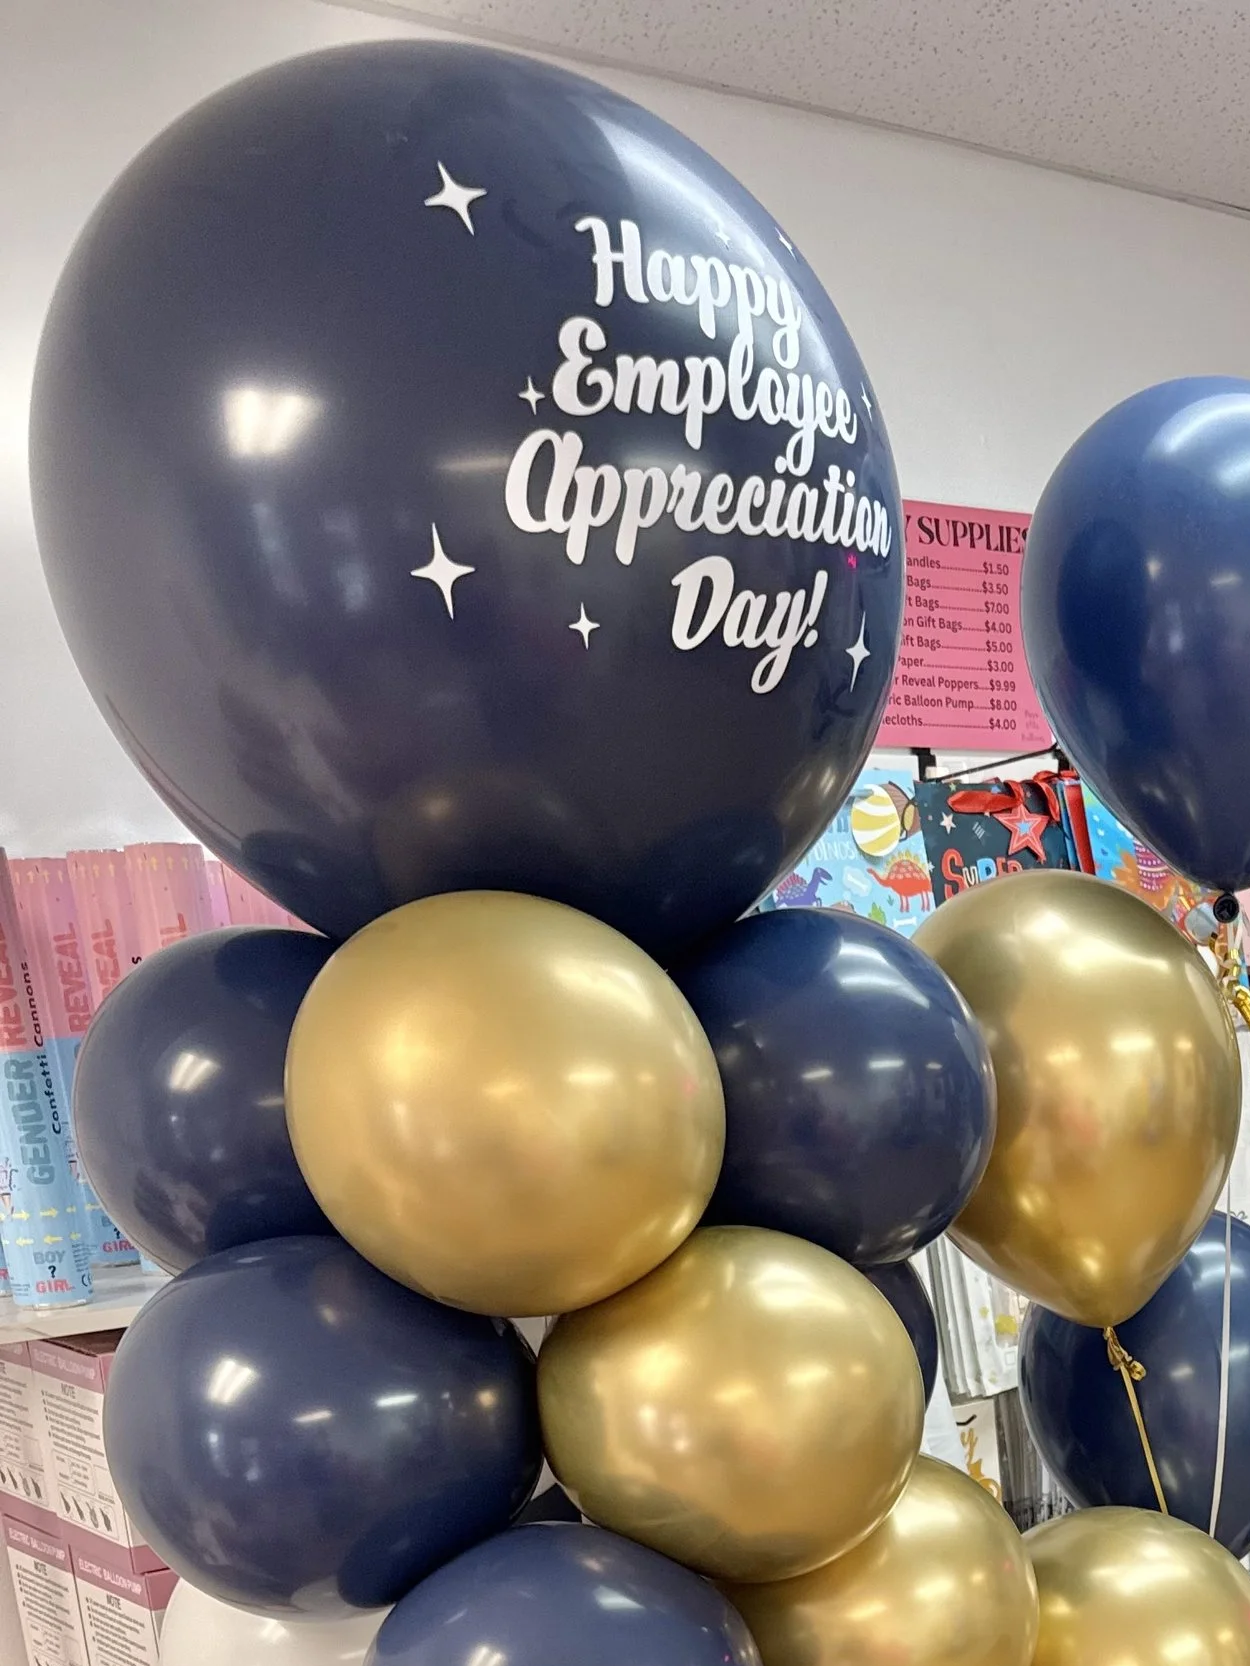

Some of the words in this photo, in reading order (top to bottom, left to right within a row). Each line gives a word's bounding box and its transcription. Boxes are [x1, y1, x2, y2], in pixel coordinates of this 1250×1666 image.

[574, 216, 801, 368] Happy
[552, 316, 858, 476] Employee
[505, 428, 892, 565] Appreciation
[906, 556, 941, 569] andles
[907, 575, 931, 590] Bags
[982, 581, 1009, 595] $3.50
[915, 596, 940, 611] Bags
[671, 554, 828, 694] Day!
[916, 616, 935, 629] Gift
[938, 617, 963, 633] Bags
[985, 620, 1012, 634] $4.00
[901, 634, 914, 647] ift
[917, 635, 942, 651] Bags
[986, 639, 1013, 654] $5.00
[899, 656, 925, 669] aper
[987, 660, 1014, 673] $3.00
[902, 674, 935, 688] Reveal
[938, 676, 979, 692] Poppers
[989, 679, 1016, 692] $9.99
[904, 694, 942, 708] Balloon
[945, 696, 974, 712] Pump
[882, 714, 923, 727] ecloths
[989, 718, 1017, 731] $4.00
[53, 922, 93, 1034] REVEAL
[20, 961, 44, 1048] Cannons
[36, 1054, 62, 1135] Confetti
[4, 1057, 55, 1186] GENDER
[33, 1250, 67, 1265] BOY
[36, 1279, 73, 1294] GIRL
